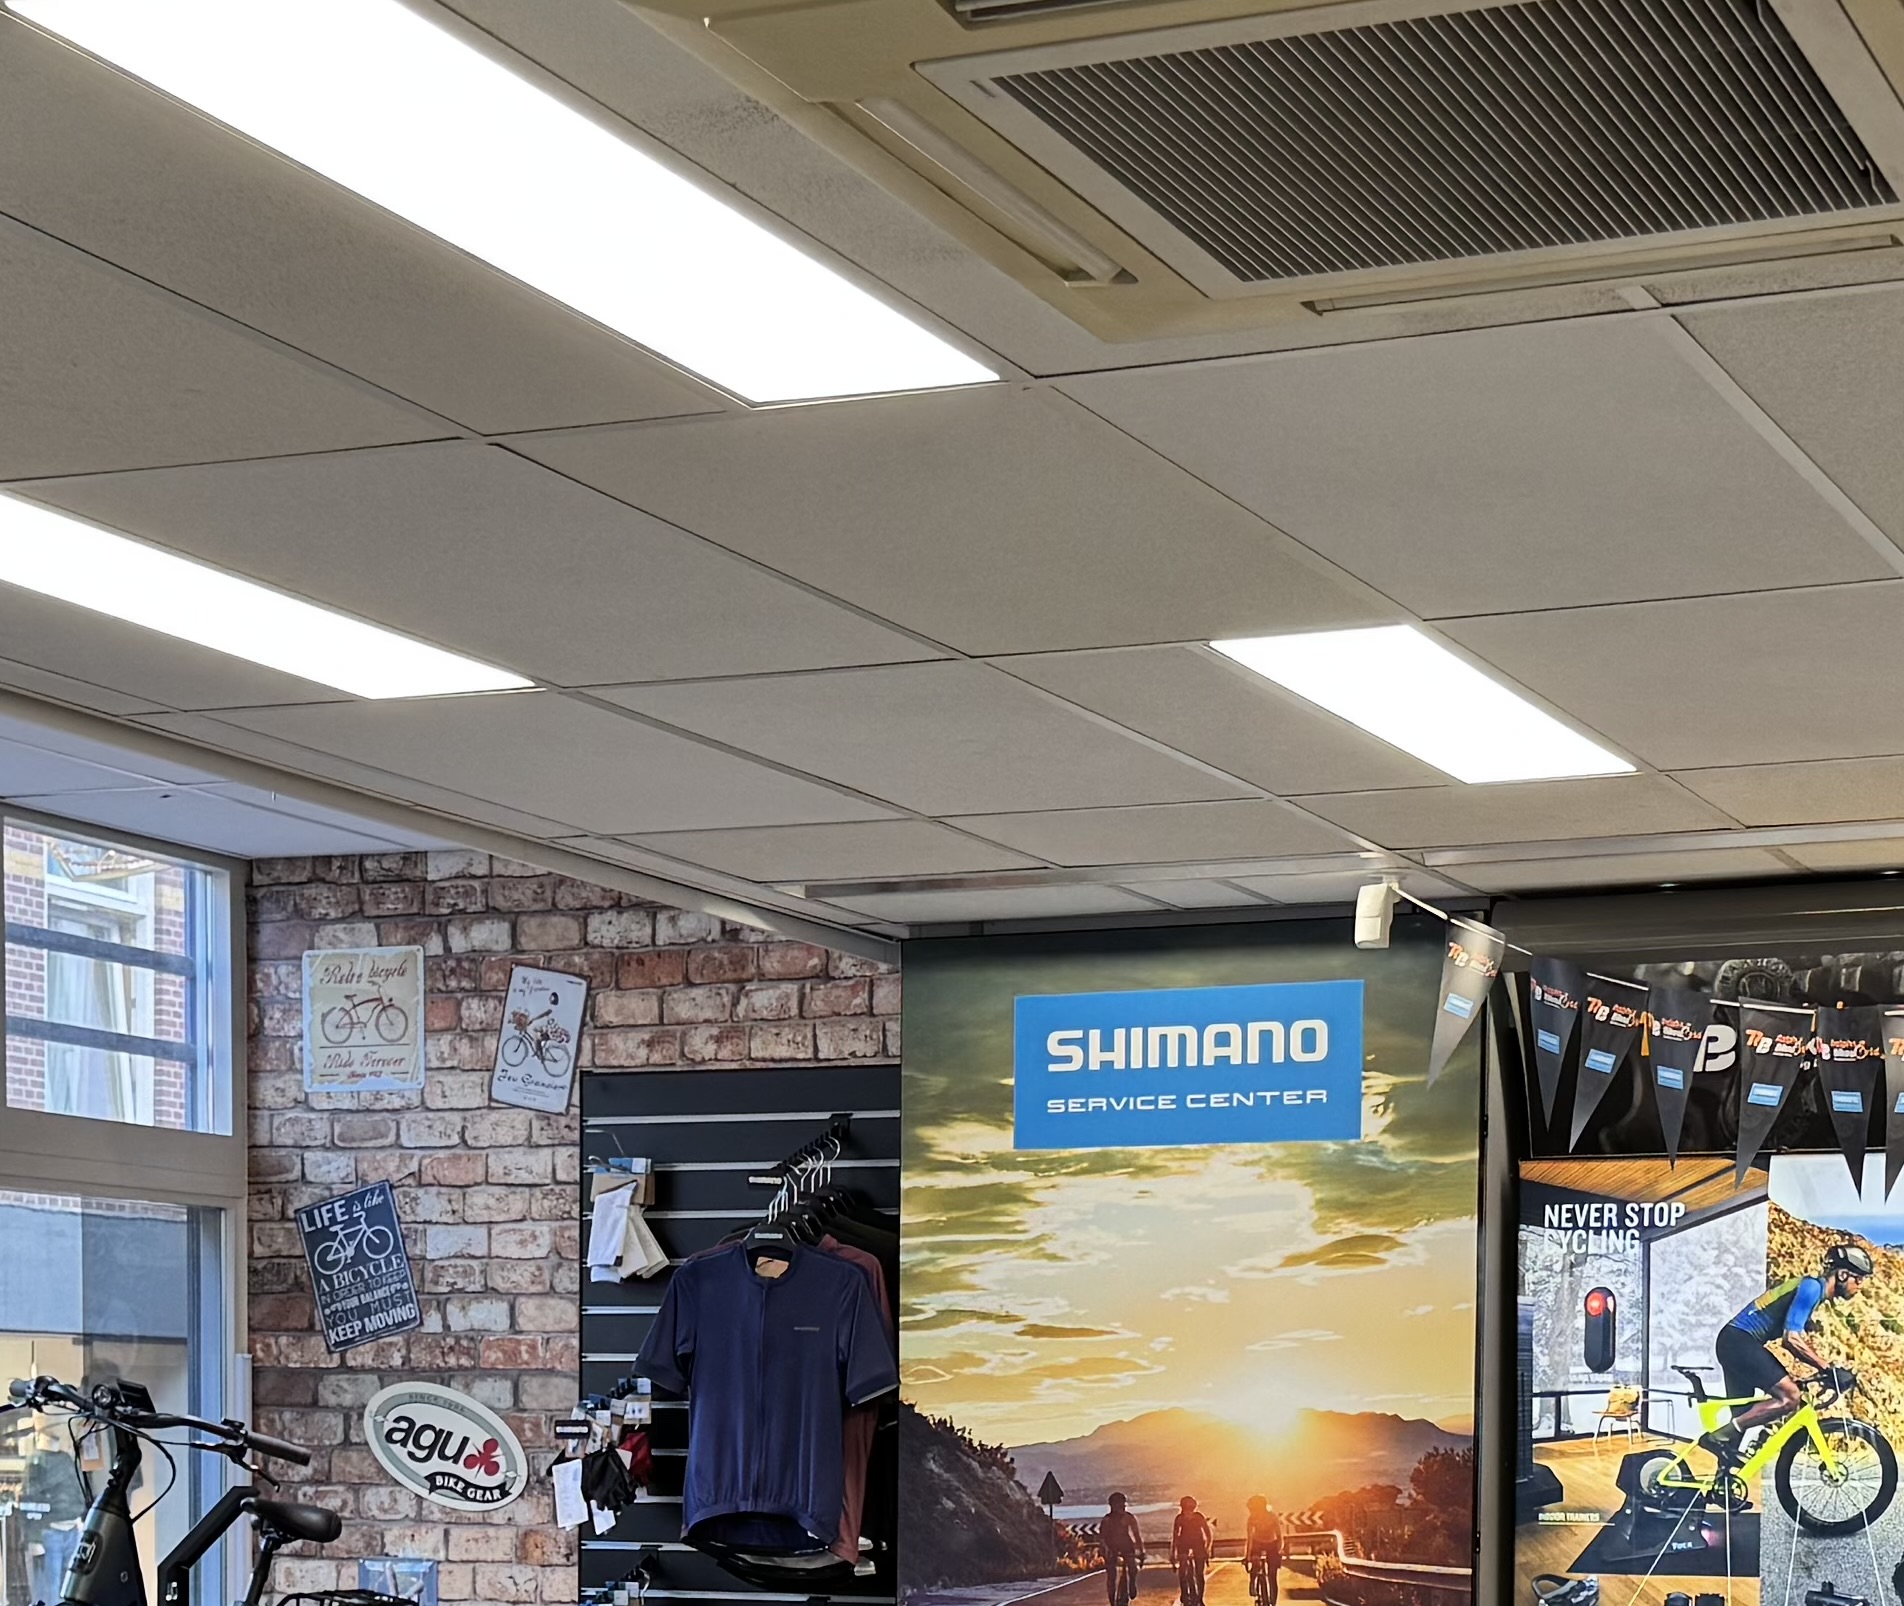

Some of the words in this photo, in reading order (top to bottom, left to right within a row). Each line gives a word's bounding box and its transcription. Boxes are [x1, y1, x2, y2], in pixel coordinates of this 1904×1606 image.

[1047, 1019, 1329, 1073] SHIMANO
[1047, 1093, 1177, 1114] SERVICE
[1186, 1089, 1328, 1109] CENTER
[301, 1200, 349, 1232] LIFE
[1543, 1203, 1620, 1230] NEVER
[1625, 1201, 1686, 1228] STOP
[1543, 1227, 1641, 1256] CYCLING
[319, 1278, 331, 1295] A
[332, 1253, 406, 1290] BICYCLE
[326, 1310, 359, 1327] YOU
[370, 1292, 412, 1313] MUST
[328, 1320, 363, 1345] KEEP
[364, 1303, 417, 1333] MOVING
[384, 1415, 471, 1464] agu
[435, 1474, 465, 1493] BIKE
[466, 1486, 502, 1502] GEAR
